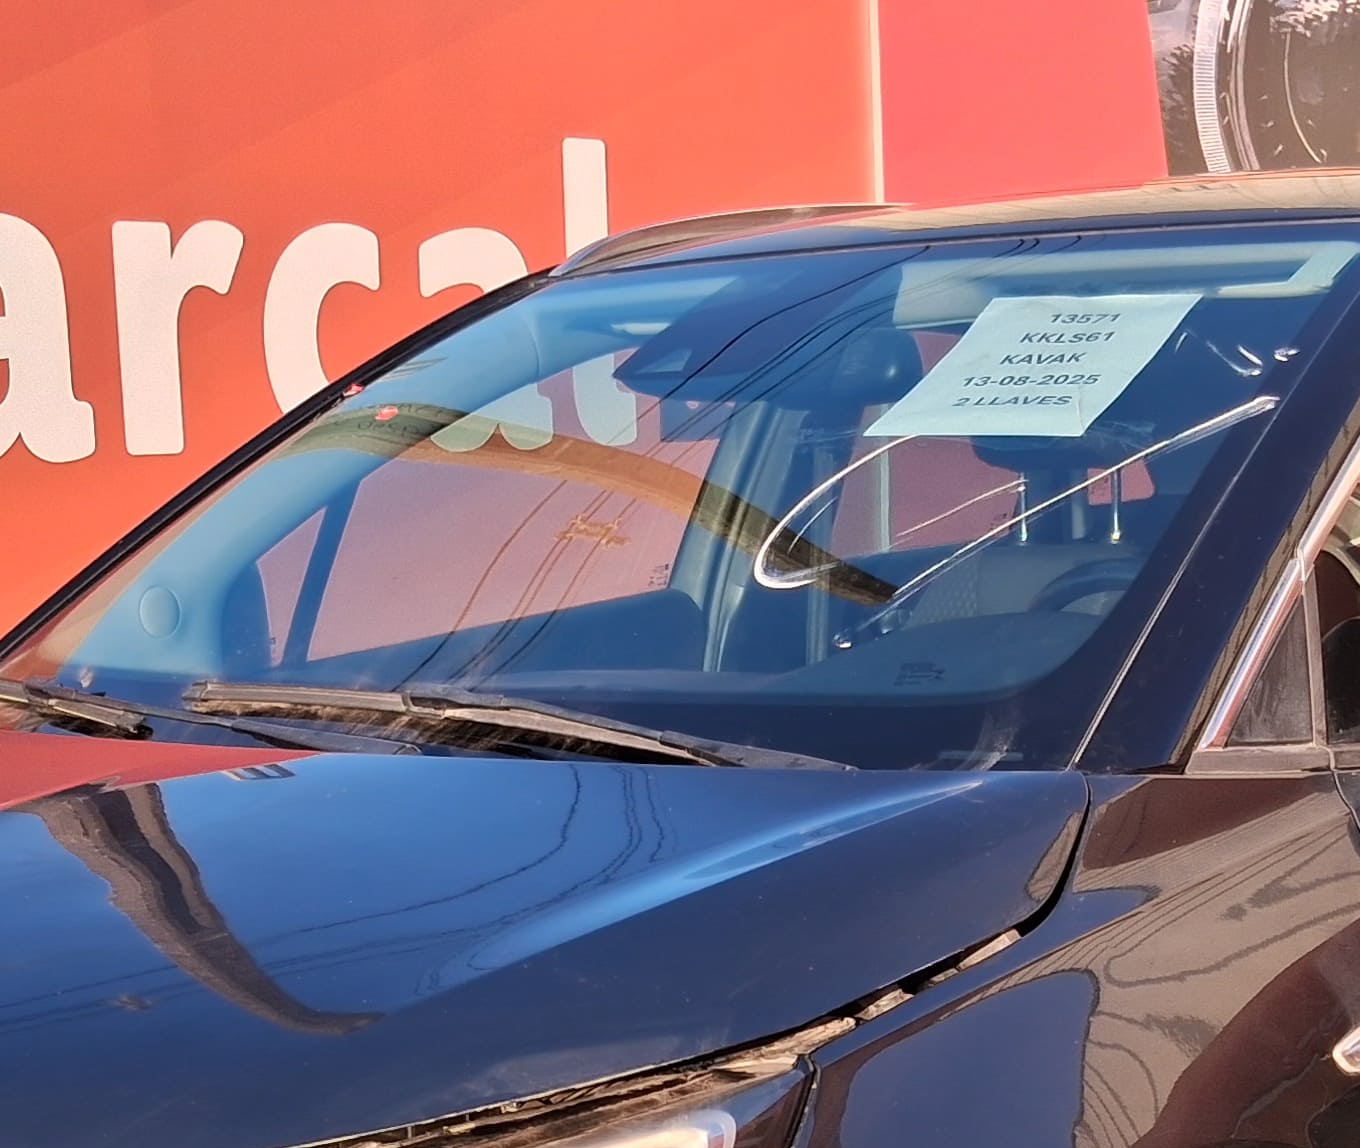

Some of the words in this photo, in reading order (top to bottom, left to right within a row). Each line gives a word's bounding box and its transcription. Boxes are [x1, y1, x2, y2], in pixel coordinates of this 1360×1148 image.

[1050, 313, 1120, 324] 13571
[1020, 331, 1116, 343] KKLS61
[1000, 352, 1086, 364] KAVAK
[963, 374, 1100, 387] 13-08-2025
[973, 395, 1073, 406] LLAVES
